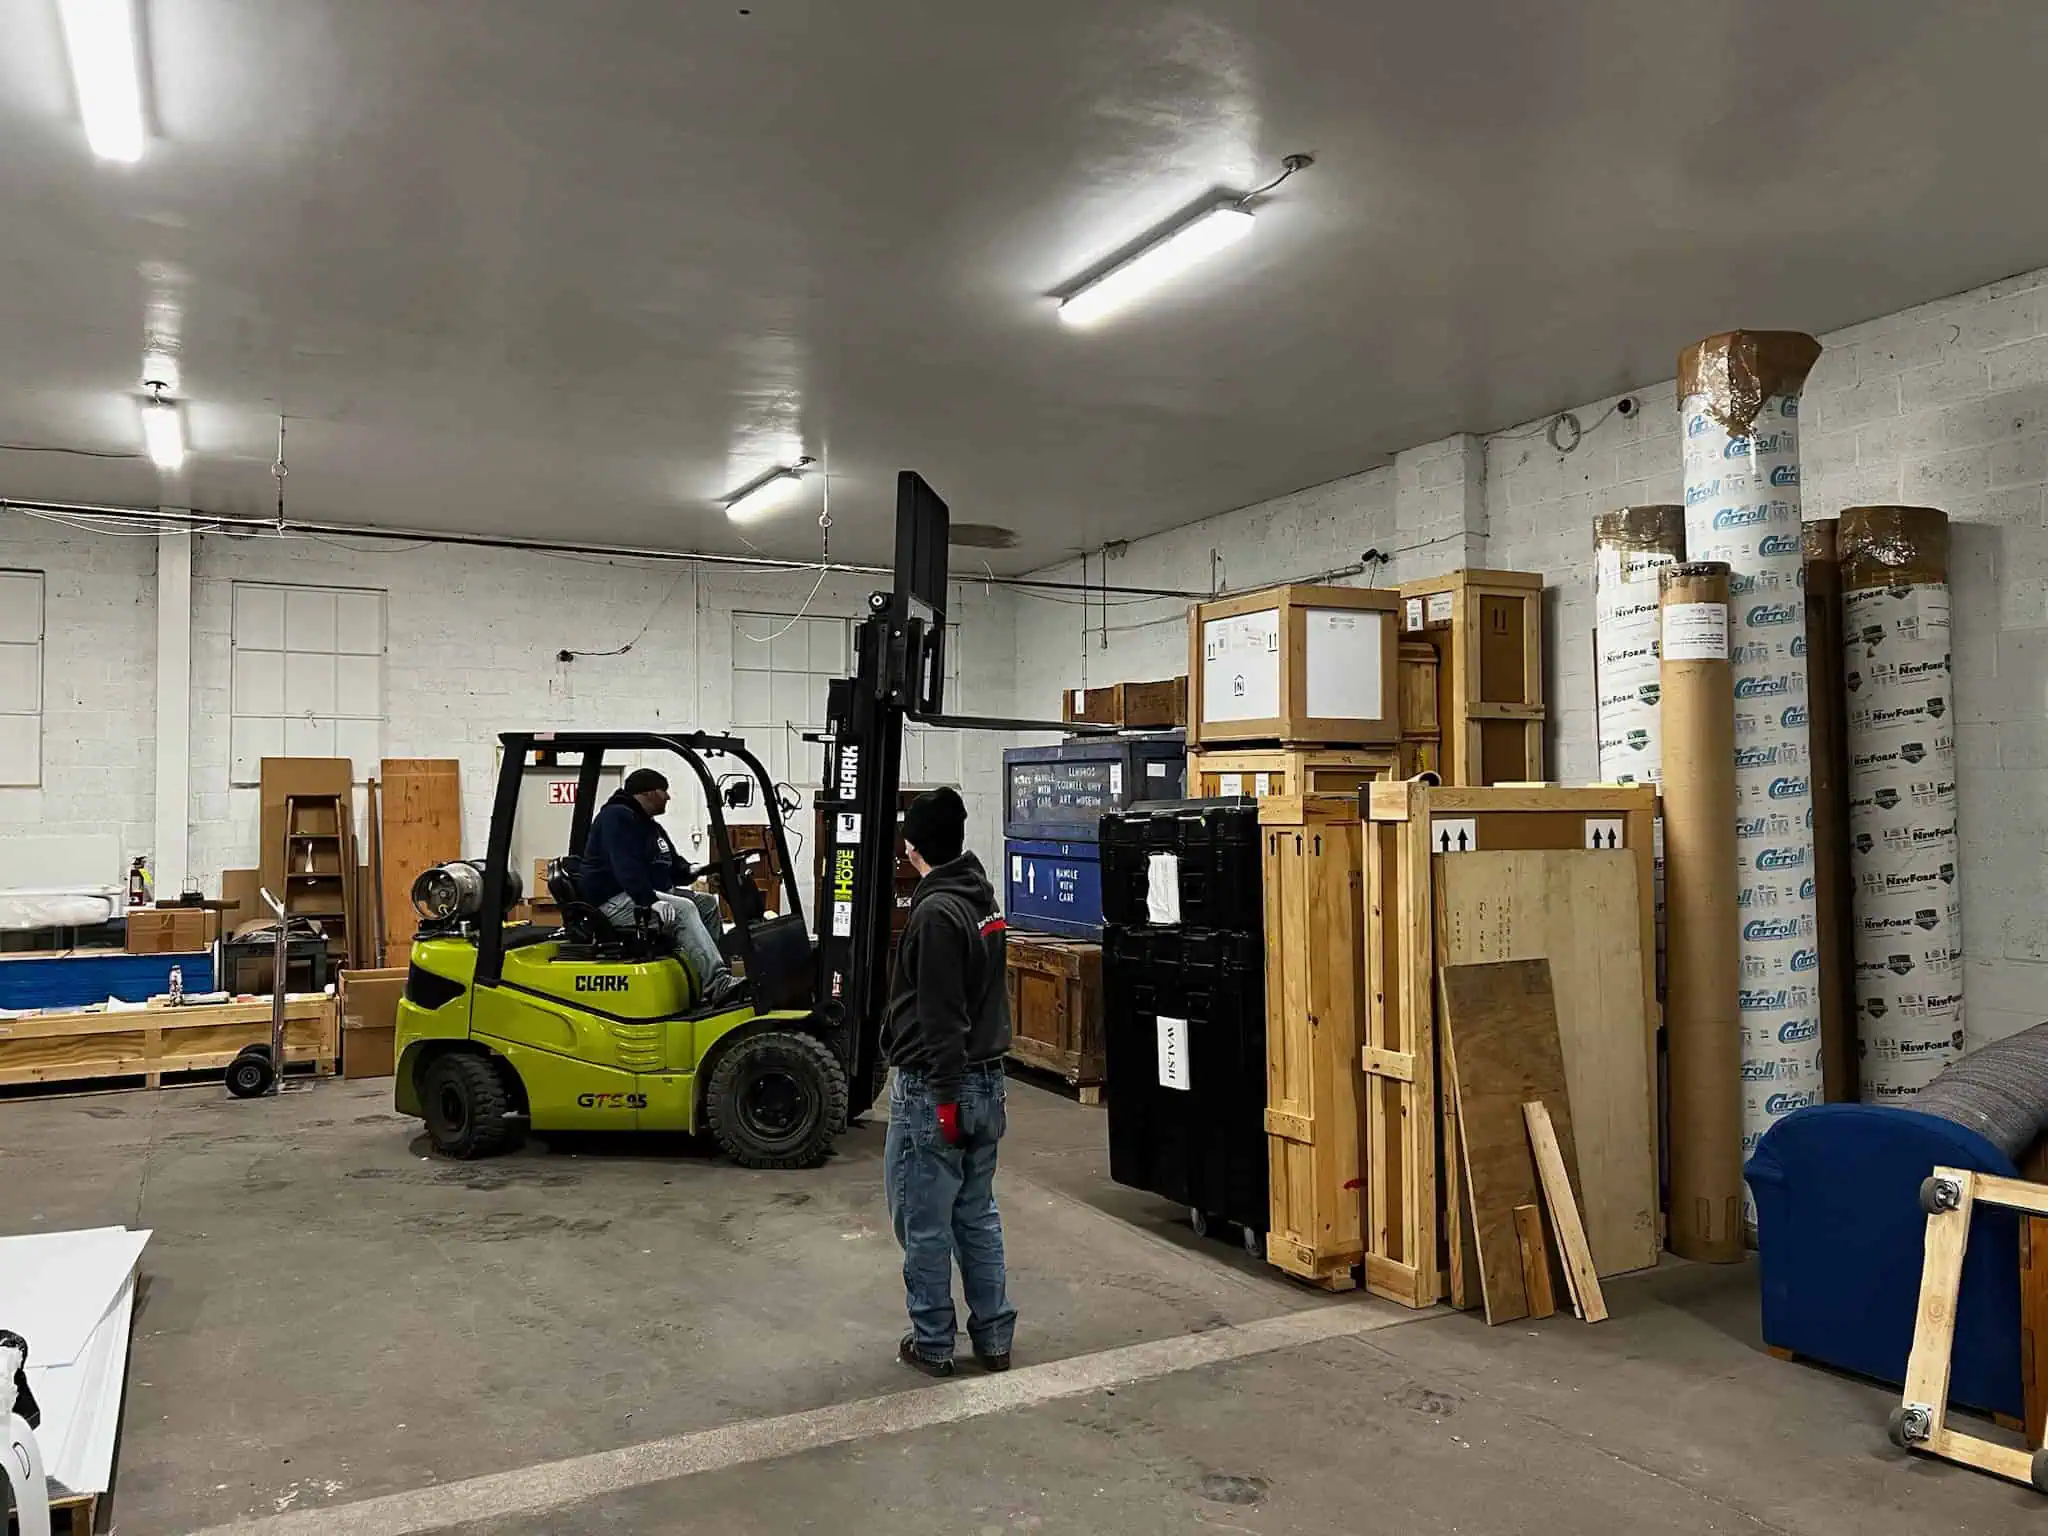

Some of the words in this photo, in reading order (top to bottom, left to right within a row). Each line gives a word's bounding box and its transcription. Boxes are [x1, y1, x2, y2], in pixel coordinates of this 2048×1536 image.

[1771, 466, 1800, 487] Carr
[1713, 504, 1768, 530] Carroll
[1759, 535, 1800, 557] Carrol
[1746, 604, 1796, 627] Carroll
[1735, 676, 1788, 699] Carroll
[840, 745, 859, 800] CLARK
[551, 783, 578, 802] EXI
[1769, 776, 1808, 800] Carrol
[1737, 818, 1764, 838] roll
[1756, 847, 1804, 871] Carroll
[834, 849, 855, 897] HOPE
[1744, 919, 1798, 941] Carroll
[576, 975, 629, 992] CLARK
[1778, 1019, 1819, 1044] Carrol
[577, 1093, 624, 1109] GTS
[1765, 1090, 1815, 1115] Carroll
